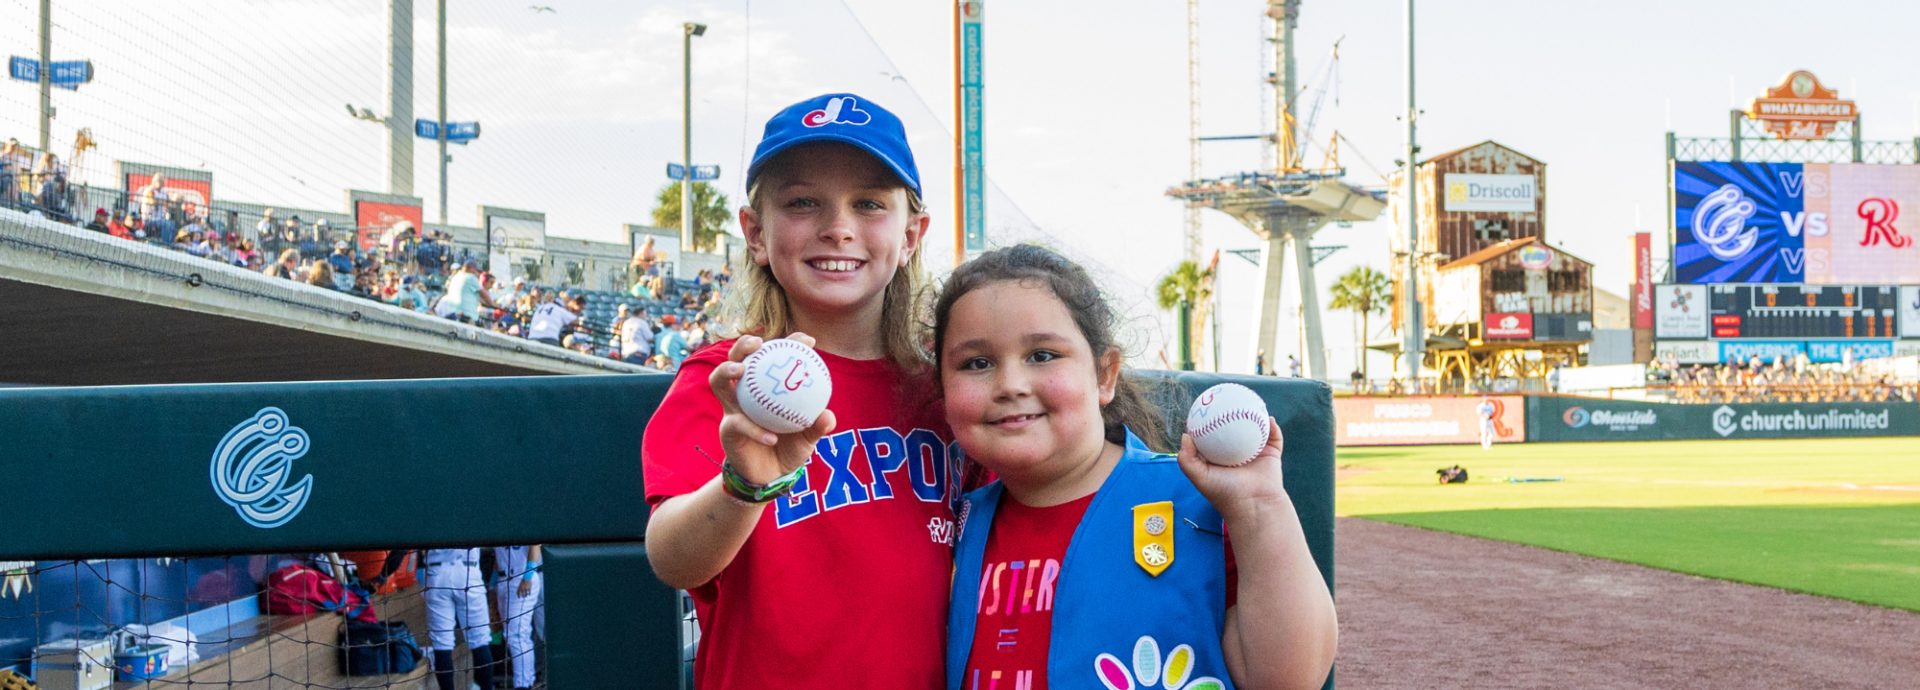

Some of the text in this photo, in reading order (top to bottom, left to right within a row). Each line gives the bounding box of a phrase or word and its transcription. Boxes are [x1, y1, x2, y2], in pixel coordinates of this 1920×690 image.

[967, 26, 982, 84] curbside
[966, 86, 982, 132] pickup
[1760, 103, 1851, 116] WHATABURGER
[1469, 183, 1532, 200] Driscoll
[1779, 172, 1828, 198] VS
[1780, 211, 1828, 237] VS
[1660, 344, 1700, 359] reliant
[1724, 343, 1890, 358] POWERING THE HOOKS
[775, 426, 965, 529] EXPOS
